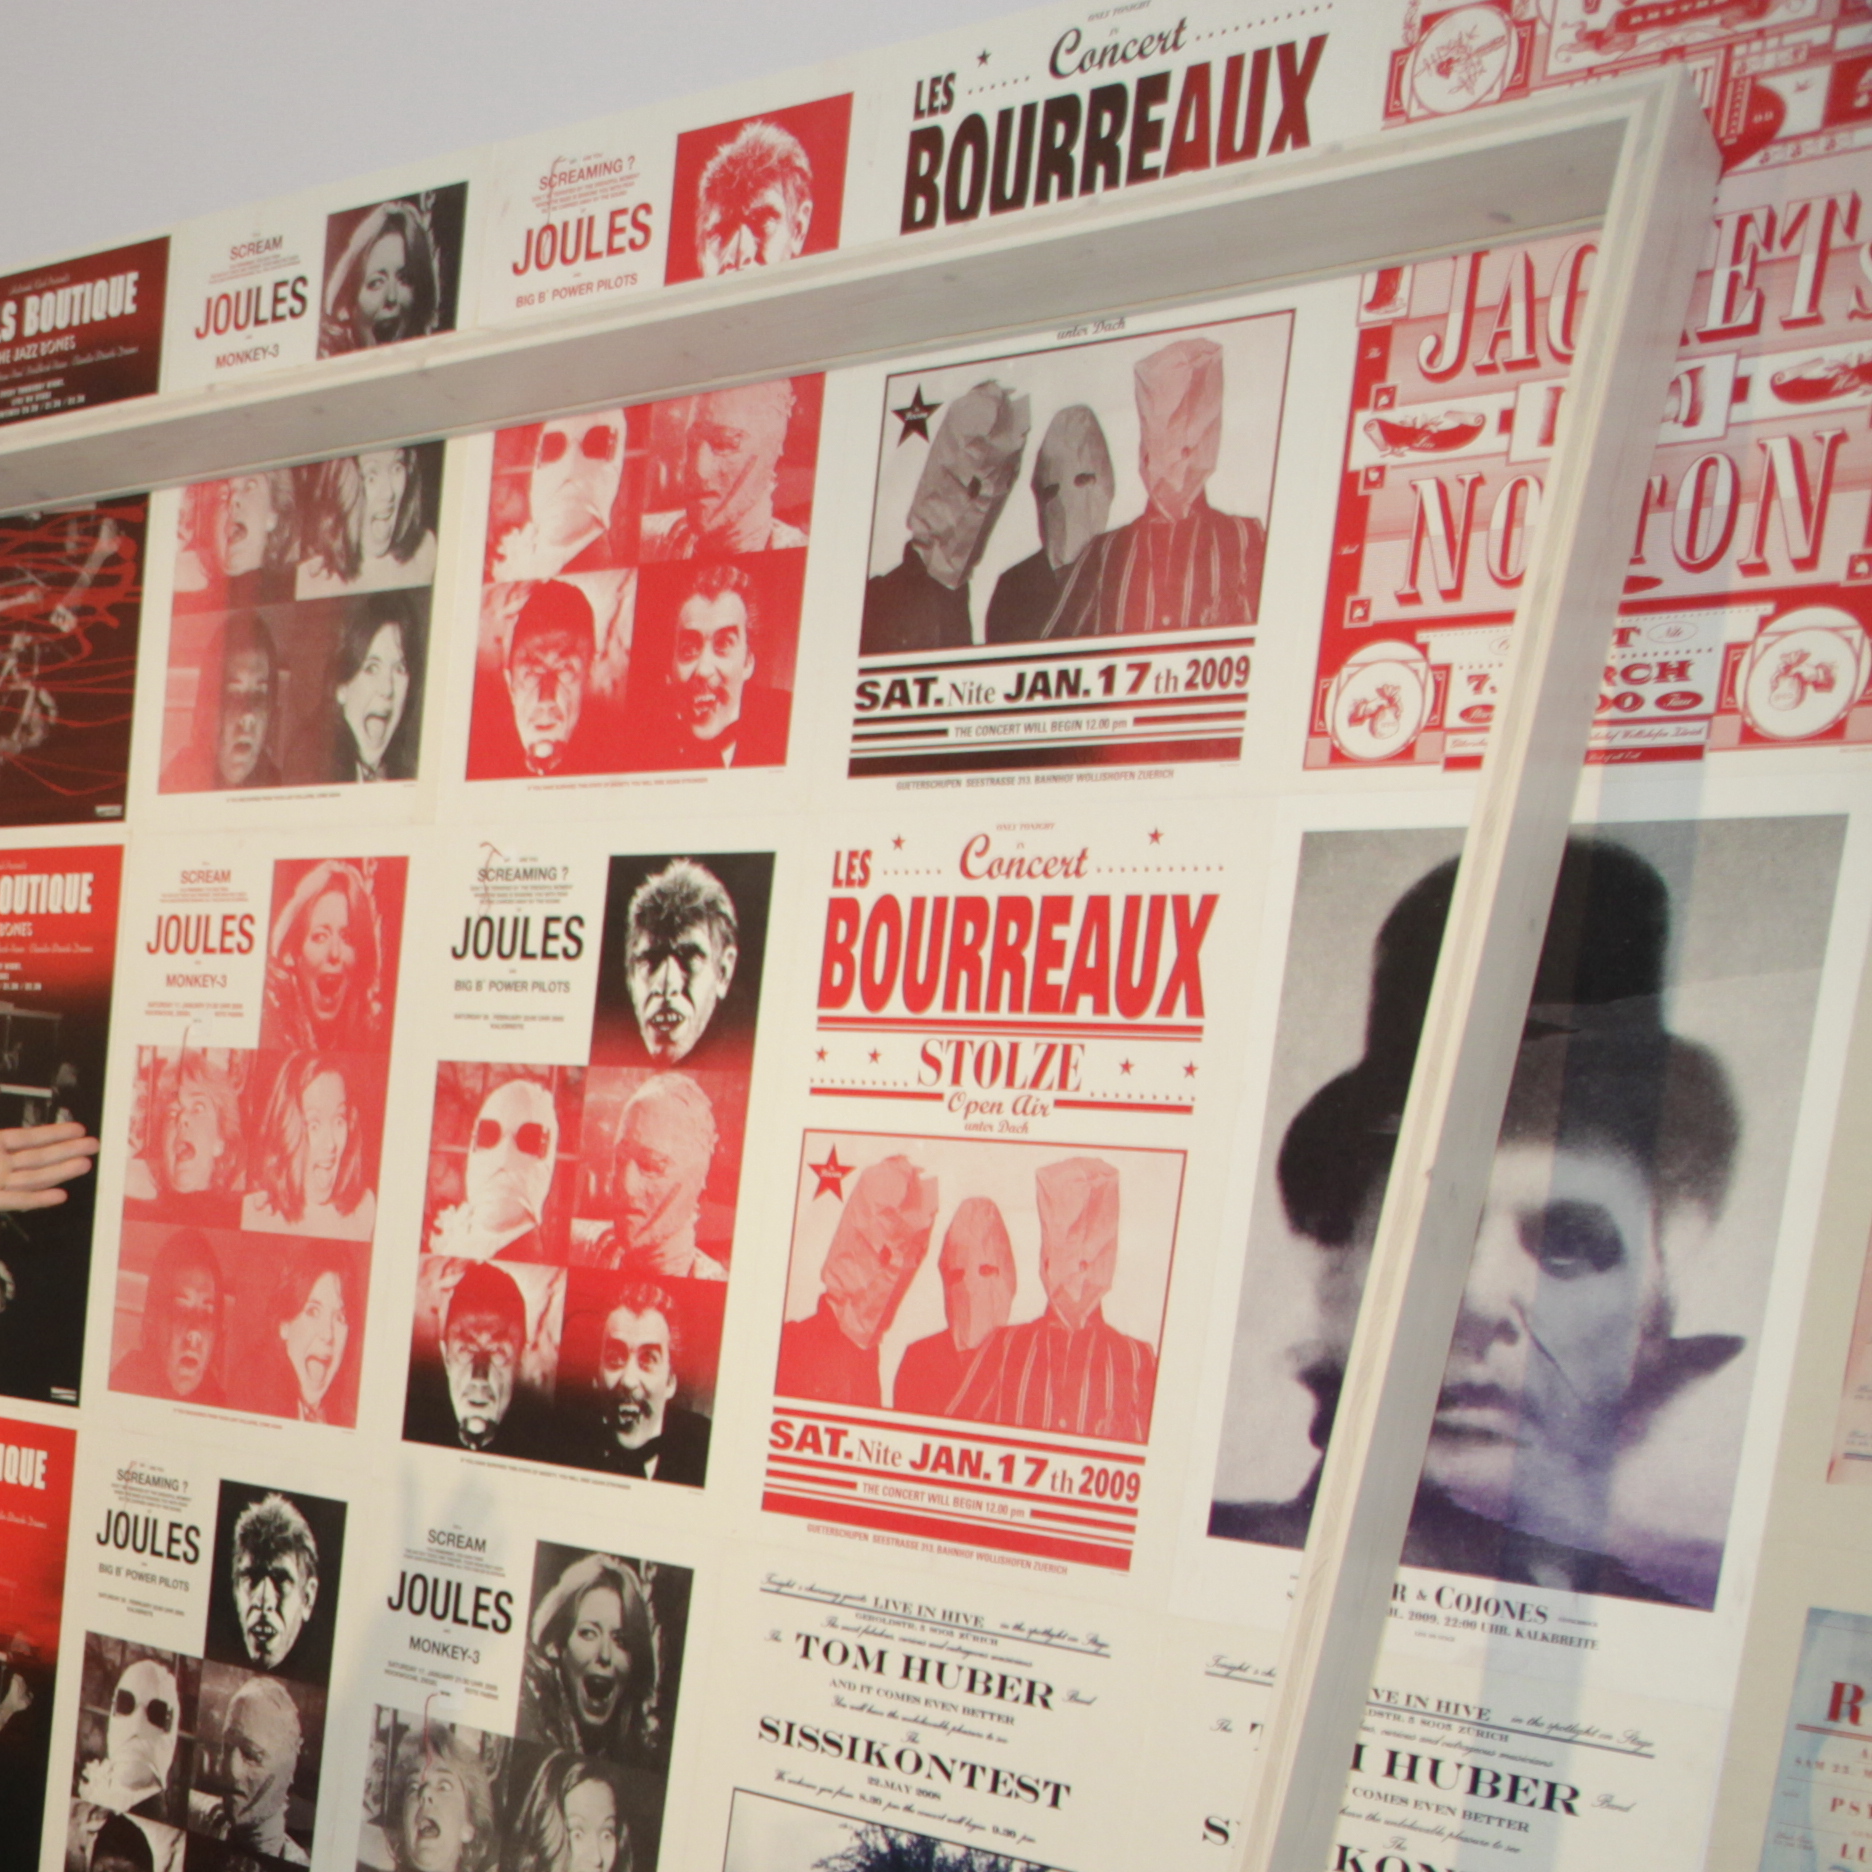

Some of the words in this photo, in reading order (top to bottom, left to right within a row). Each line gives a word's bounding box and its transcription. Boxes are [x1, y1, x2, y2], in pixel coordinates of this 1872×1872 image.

[1049, 18, 1187, 80] Concert
[914, 71, 956, 121] LES
[900, 32, 1330, 236] BOURREAUX
[539, 158, 623, 191] SCREAMING
[230, 235, 283, 261] SCREAM
[512, 203, 653, 276] JOULES
[23, 271, 139, 337] BOUTIQUE
[195, 275, 308, 340] JOULES
[516, 292, 534, 308] BIG
[552, 282, 593, 300] POWER
[597, 272, 638, 292] PILOTS
[1056, 322, 1089, 341] unter
[1093, 316, 1127, 335] Dach
[14, 343, 38, 361] JAZZ
[216, 343, 279, 369] MONKEY-3
[855, 676, 945, 713] SAT.
[948, 681, 996, 707] Nite
[1004, 668, 1091, 704] JAN.
[1154, 669, 1178, 694] th
[1185, 655, 1250, 690] 2009
[955, 727, 974, 737] THE
[975, 723, 1021, 736] CONCERT
[1024, 722, 1048, 733] WILL
[1051, 720, 1082, 732] BEGIN
[1086, 719, 1109, 730] 12.00
[1112, 720, 1127, 732] pm
[1034, 774, 1074, 784] BAHNHOF
[1077, 771, 1135, 782] WOLLISHOFEN
[1137, 769, 1174, 780] ZUERICH
[832, 850, 872, 888] LES
[959, 833, 1089, 880] Concert
[181, 870, 231, 884] SCREAM
[477, 867, 557, 882] SCREAMING
[146, 913, 255, 955] JOULES
[451, 915, 585, 961] JOULES
[816, 893, 1220, 1020] BOURREAUX
[166, 974, 227, 988] MONKEY-3
[454, 980, 472, 991] BIG
[489, 980, 528, 992] POWER
[531, 981, 570, 993] PILOTS
[917, 1039, 1086, 1092] STOLZE
[947, 1091, 1005, 1117] Open
[1009, 1093, 1051, 1118] Air
[964, 1121, 995, 1134] unter
[997, 1117, 1029, 1136] Dach
[769, 1419, 854, 1459] SAT.
[858, 1438, 903, 1467] Nite
[909, 1443, 991, 1480] JAN.
[1050, 1469, 1074, 1495] th
[1078, 1465, 1141, 1503] 2009
[117, 1469, 179, 1491] SCREAMING
[863, 1482, 881, 1496] THE
[882, 1486, 925, 1504] CONCERT
[928, 1492, 950, 1507] WILL
[953, 1496, 984, 1512] BEGIN
[986, 1502, 1009, 1515] 12.00
[1010, 1507, 1025, 1519] pm
[96, 1509, 201, 1565] JOULES
[428, 1529, 486, 1552] SCREAM
[872, 1535, 920, 1551] SEESTRASSE
[937, 1543, 974, 1561] BAHNHOF
[976, 1551, 1032, 1570] WOLLISHOFEN
[1033, 1561, 1068, 1575] ZUERICH
[98, 1563, 113, 1575] BIG
[126, 1569, 156, 1584] POWER
[159, 1576, 189, 1592] PILOTS
[1417, 1589, 1426, 1601] &
[388, 1571, 514, 1634] JOULES
[874, 1597, 913, 1614] LIVE
[918, 1604, 937, 1618] IN
[942, 1609, 984, 1628] HIVE
[409, 1636, 480, 1665] MONKEY-3
[959, 1631, 999, 1646] ZÜRICH
[1444, 1616, 1477, 1630] 22:00
[1515, 1628, 1599, 1650] KALKBREITE
[795, 1631, 889, 1676] TOM
[899, 1653, 1054, 1711] HUBER
[829, 1678, 856, 1692] AND
[860, 1684, 873, 1695] IT
[877, 1688, 921, 1705] COMES
[924, 1696, 958, 1713] EVEN
[962, 1702, 1015, 1726] BETTER
[1405, 1694, 1429, 1709] IN
[1436, 1699, 1491, 1720] HIVE
[1458, 1726, 1509, 1743] ZÜRICH
[758, 1715, 1072, 1810] SISSIKONTEST
[1382, 1748, 1580, 1817] HUBER
[1591, 1794, 1637, 1813] Band
[1352, 1786, 1408, 1806] COMES
[1413, 1799, 1457, 1816] EVEN
[1461, 1809, 1530, 1833] BETTER
[1383, 1835, 1408, 1851] The
